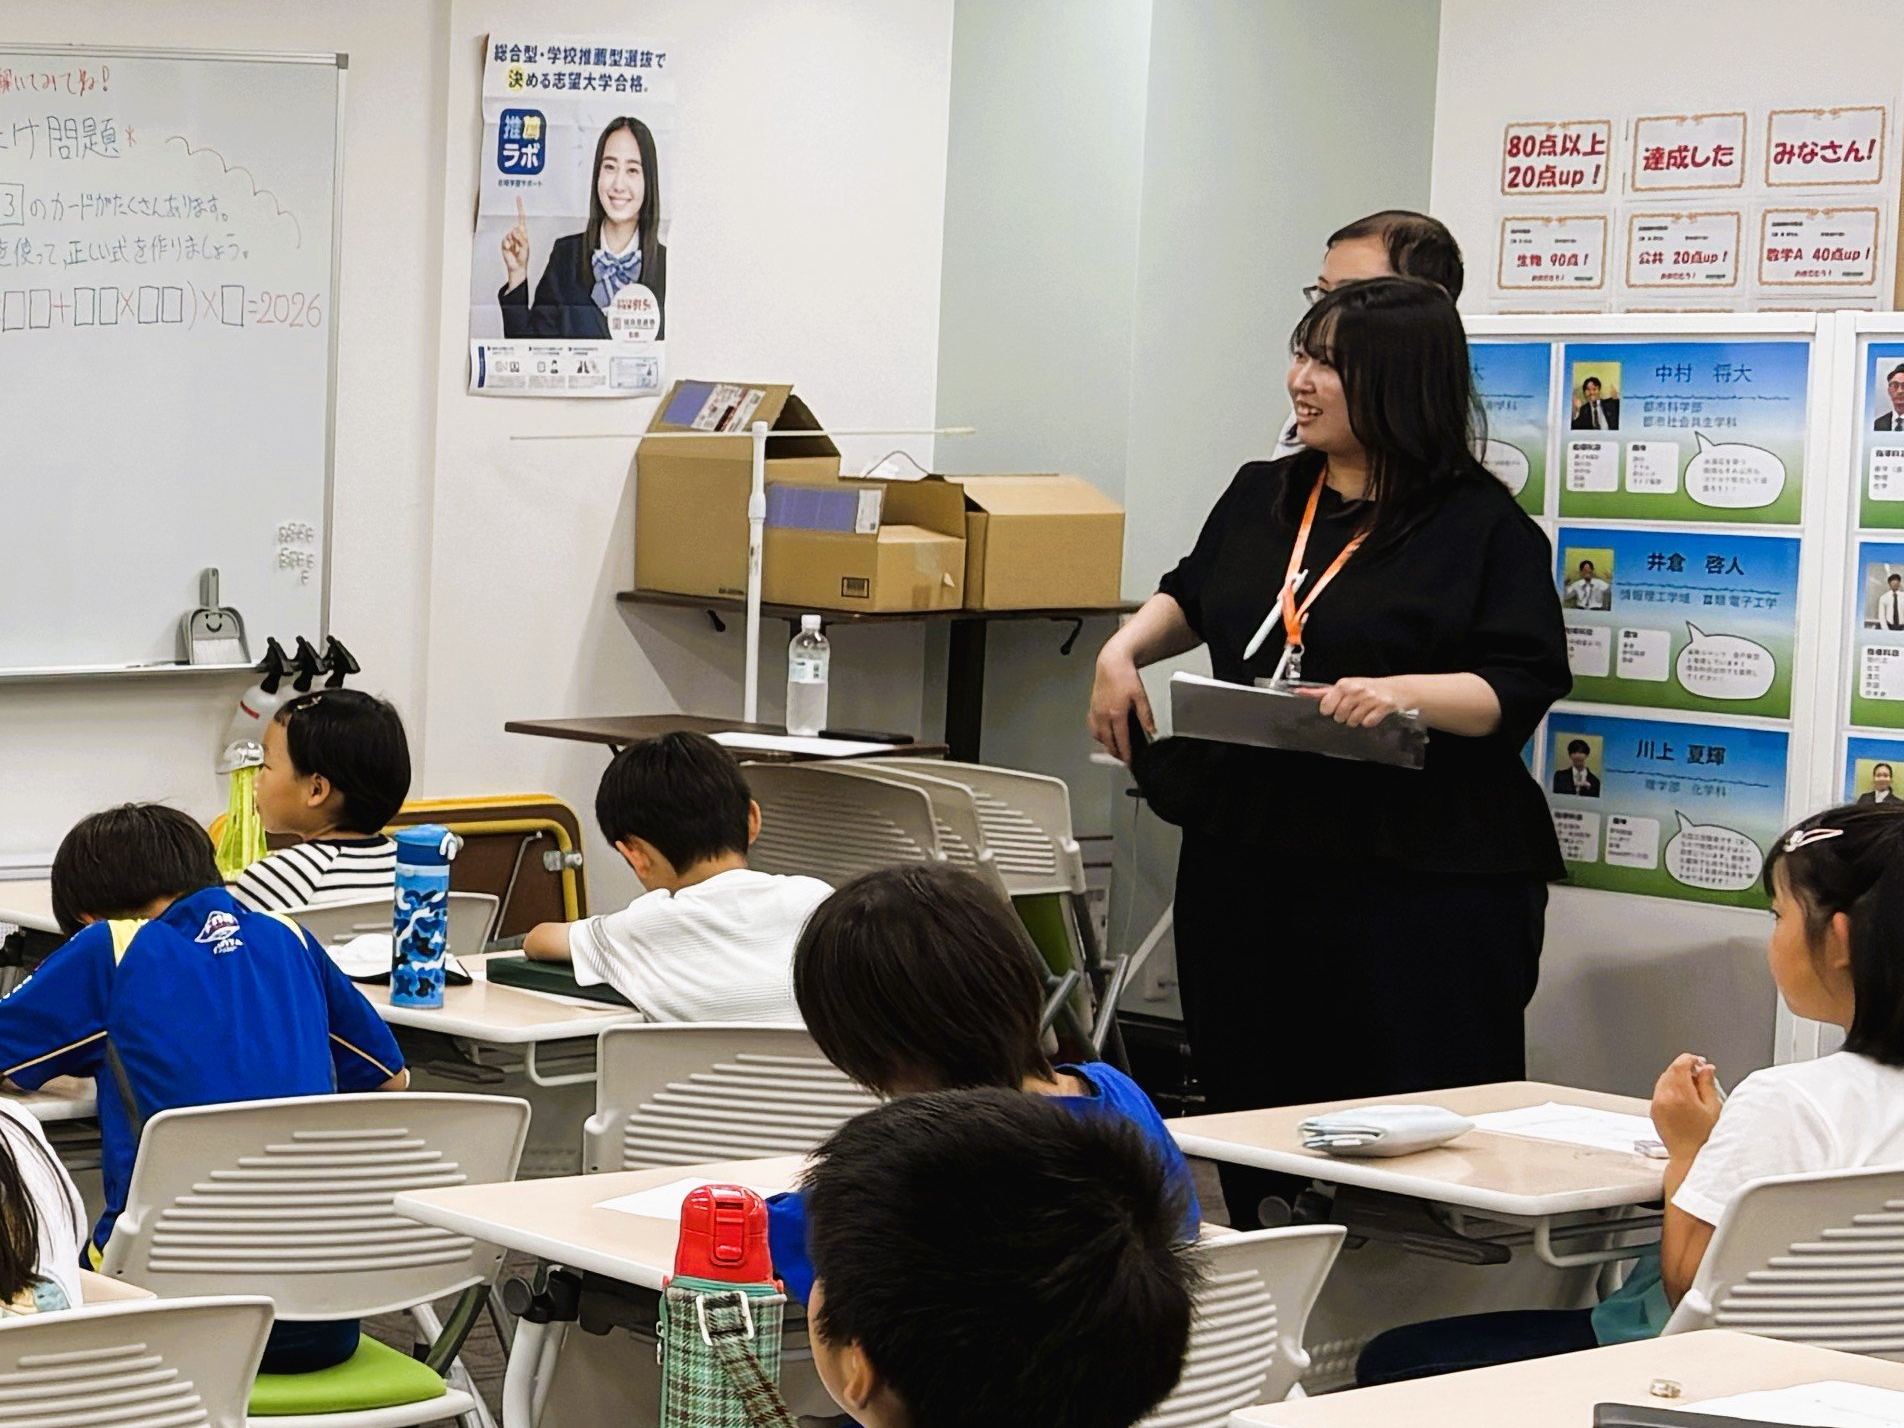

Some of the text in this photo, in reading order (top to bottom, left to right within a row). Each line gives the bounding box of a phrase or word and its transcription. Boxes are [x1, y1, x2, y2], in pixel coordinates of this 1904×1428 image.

[508, 69, 649, 94] 決める志望大学合格。
[502, 143, 541, 168] ラボ
[1508, 133, 1606, 159] 80点以上
[1643, 144, 1734, 172] 達成した
[1773, 139, 1876, 164] みなさん!
[1655, 363, 1692, 383] 中村
[1647, 552, 1686, 572] 井倉
[1636, 739, 1675, 761] 川上
